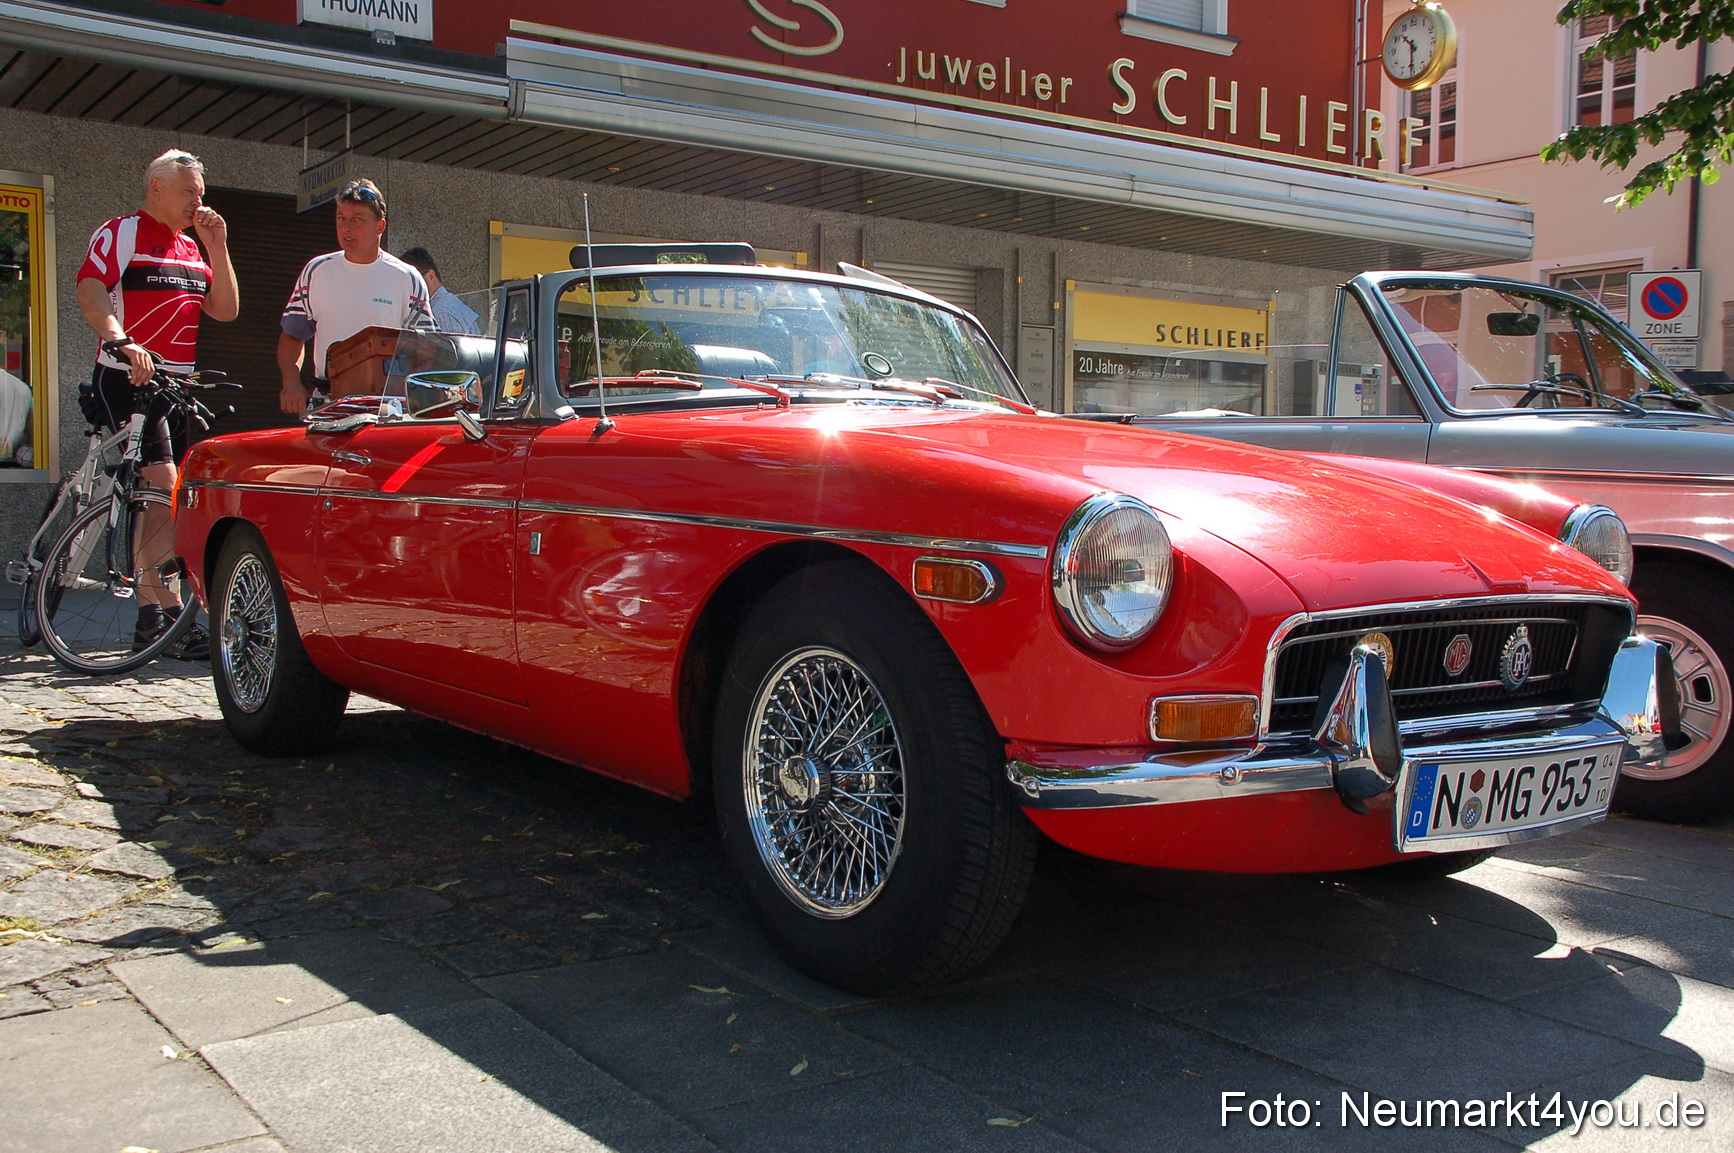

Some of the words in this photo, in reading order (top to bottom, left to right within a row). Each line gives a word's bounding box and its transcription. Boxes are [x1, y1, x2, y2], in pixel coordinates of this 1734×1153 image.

[1111, 57, 1424, 167] SCHLIERF
[0, 194, 31, 208] TTO
[1156, 323, 1265, 351] SCHLIERF
[1645, 322, 1683, 335] ZONE
[1079, 356, 1103, 374] 20
[1105, 358, 1124, 375] Jahre
[1602, 753, 1614, 768] 04
[1432, 771, 1466, 830] N
[1485, 766, 1536, 824] MG
[1539, 755, 1598, 816] 953
[1595, 788, 1606, 803] 10
[1412, 810, 1423, 827] D
